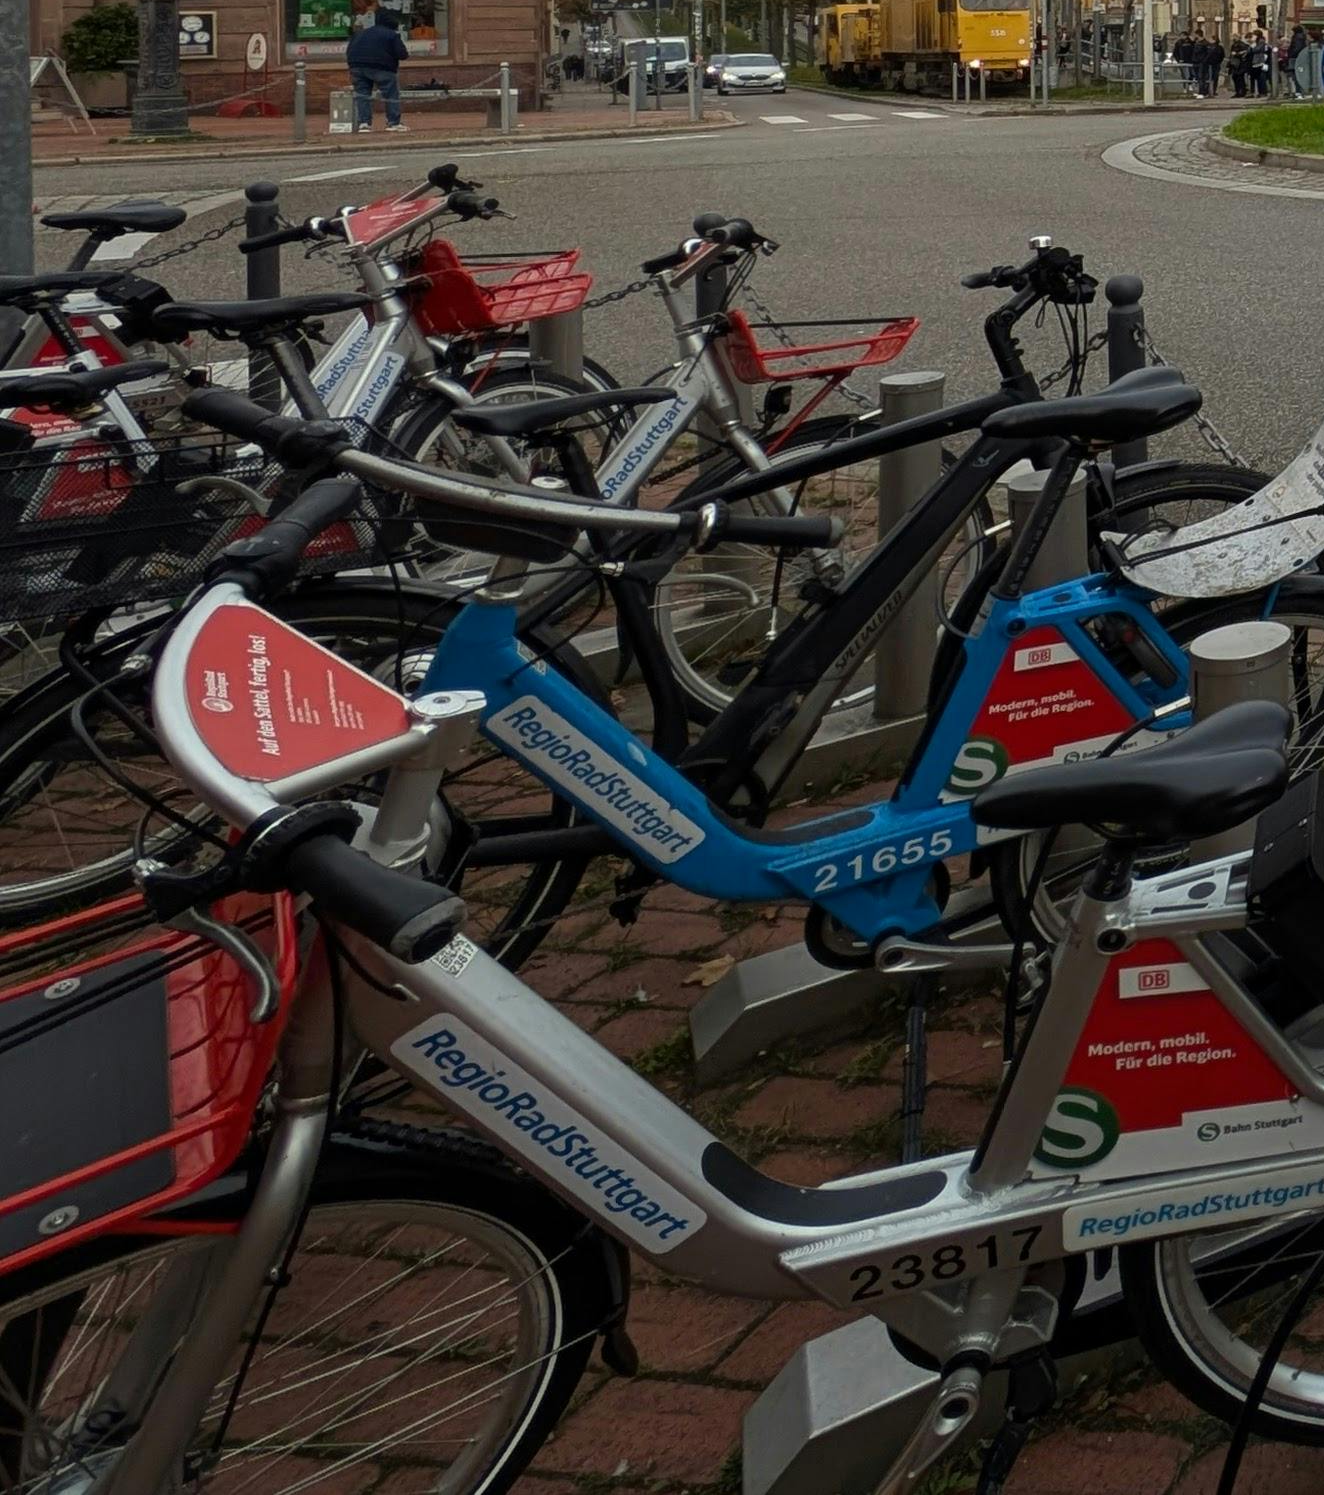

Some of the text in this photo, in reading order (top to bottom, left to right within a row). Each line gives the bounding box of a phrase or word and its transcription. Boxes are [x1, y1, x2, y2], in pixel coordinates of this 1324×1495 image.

[247, 634, 266, 654] los!
[1030, 650, 1050, 664] DB
[988, 689, 1077, 715] Modern, mobil.
[1008, 698, 1095, 722] Für die Region.
[256, 720, 276, 737] den
[257, 736, 281, 756] Auf
[503, 705, 693, 853] RegioRadStuttgart
[814, 829, 952, 893] 21655
[1140, 971, 1167, 990] DB
[1088, 1032, 1210, 1057] Modern, mobil.
[1115, 1048, 1237, 1071] Für die Region.
[412, 1029, 689, 1240] RegioRadStuttgart
[1223, 1124, 1252, 1134] Bahn
[1254, 1115, 1303, 1130] Stuttgart
[850, 1225, 1043, 1302] 23817
